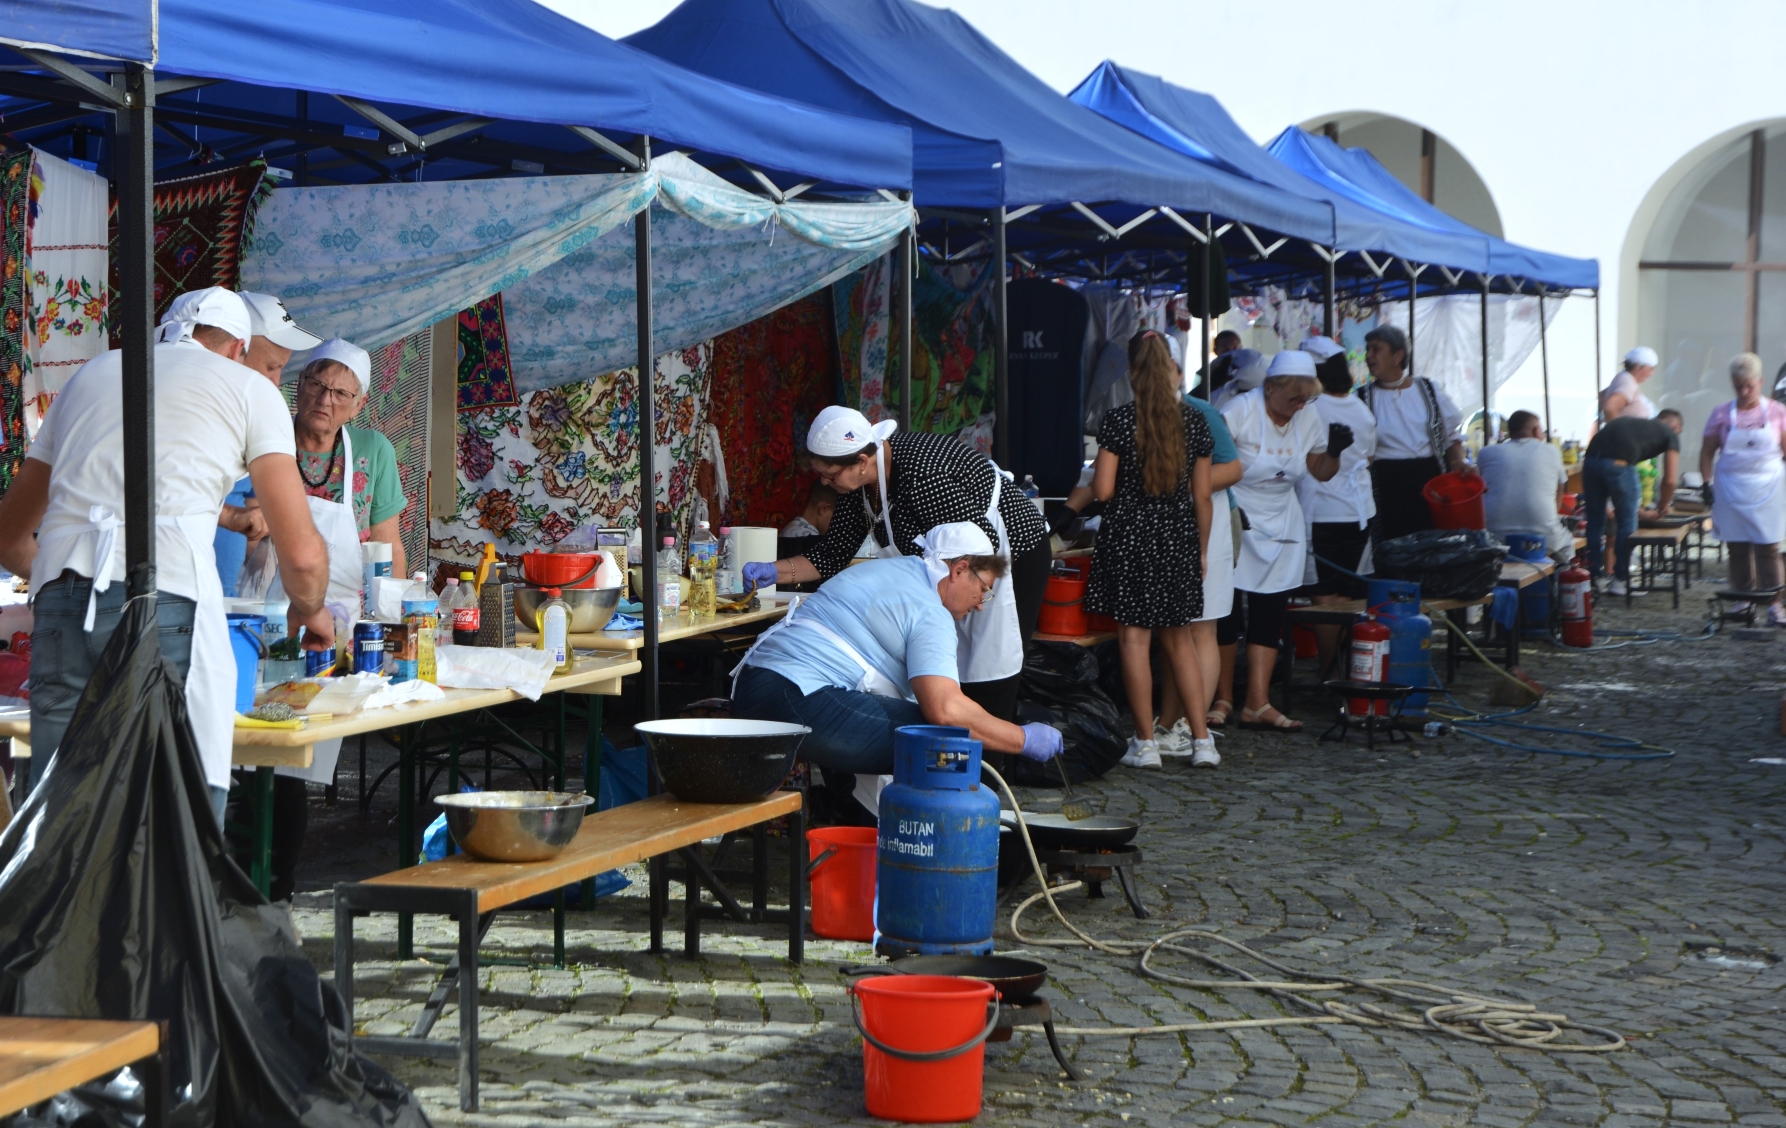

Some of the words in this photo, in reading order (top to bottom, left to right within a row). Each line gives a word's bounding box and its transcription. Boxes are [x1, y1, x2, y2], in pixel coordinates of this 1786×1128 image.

[1023, 330, 1044, 348] RK
[899, 819, 935, 836] BUTAN
[887, 836, 934, 857] inflamabil
